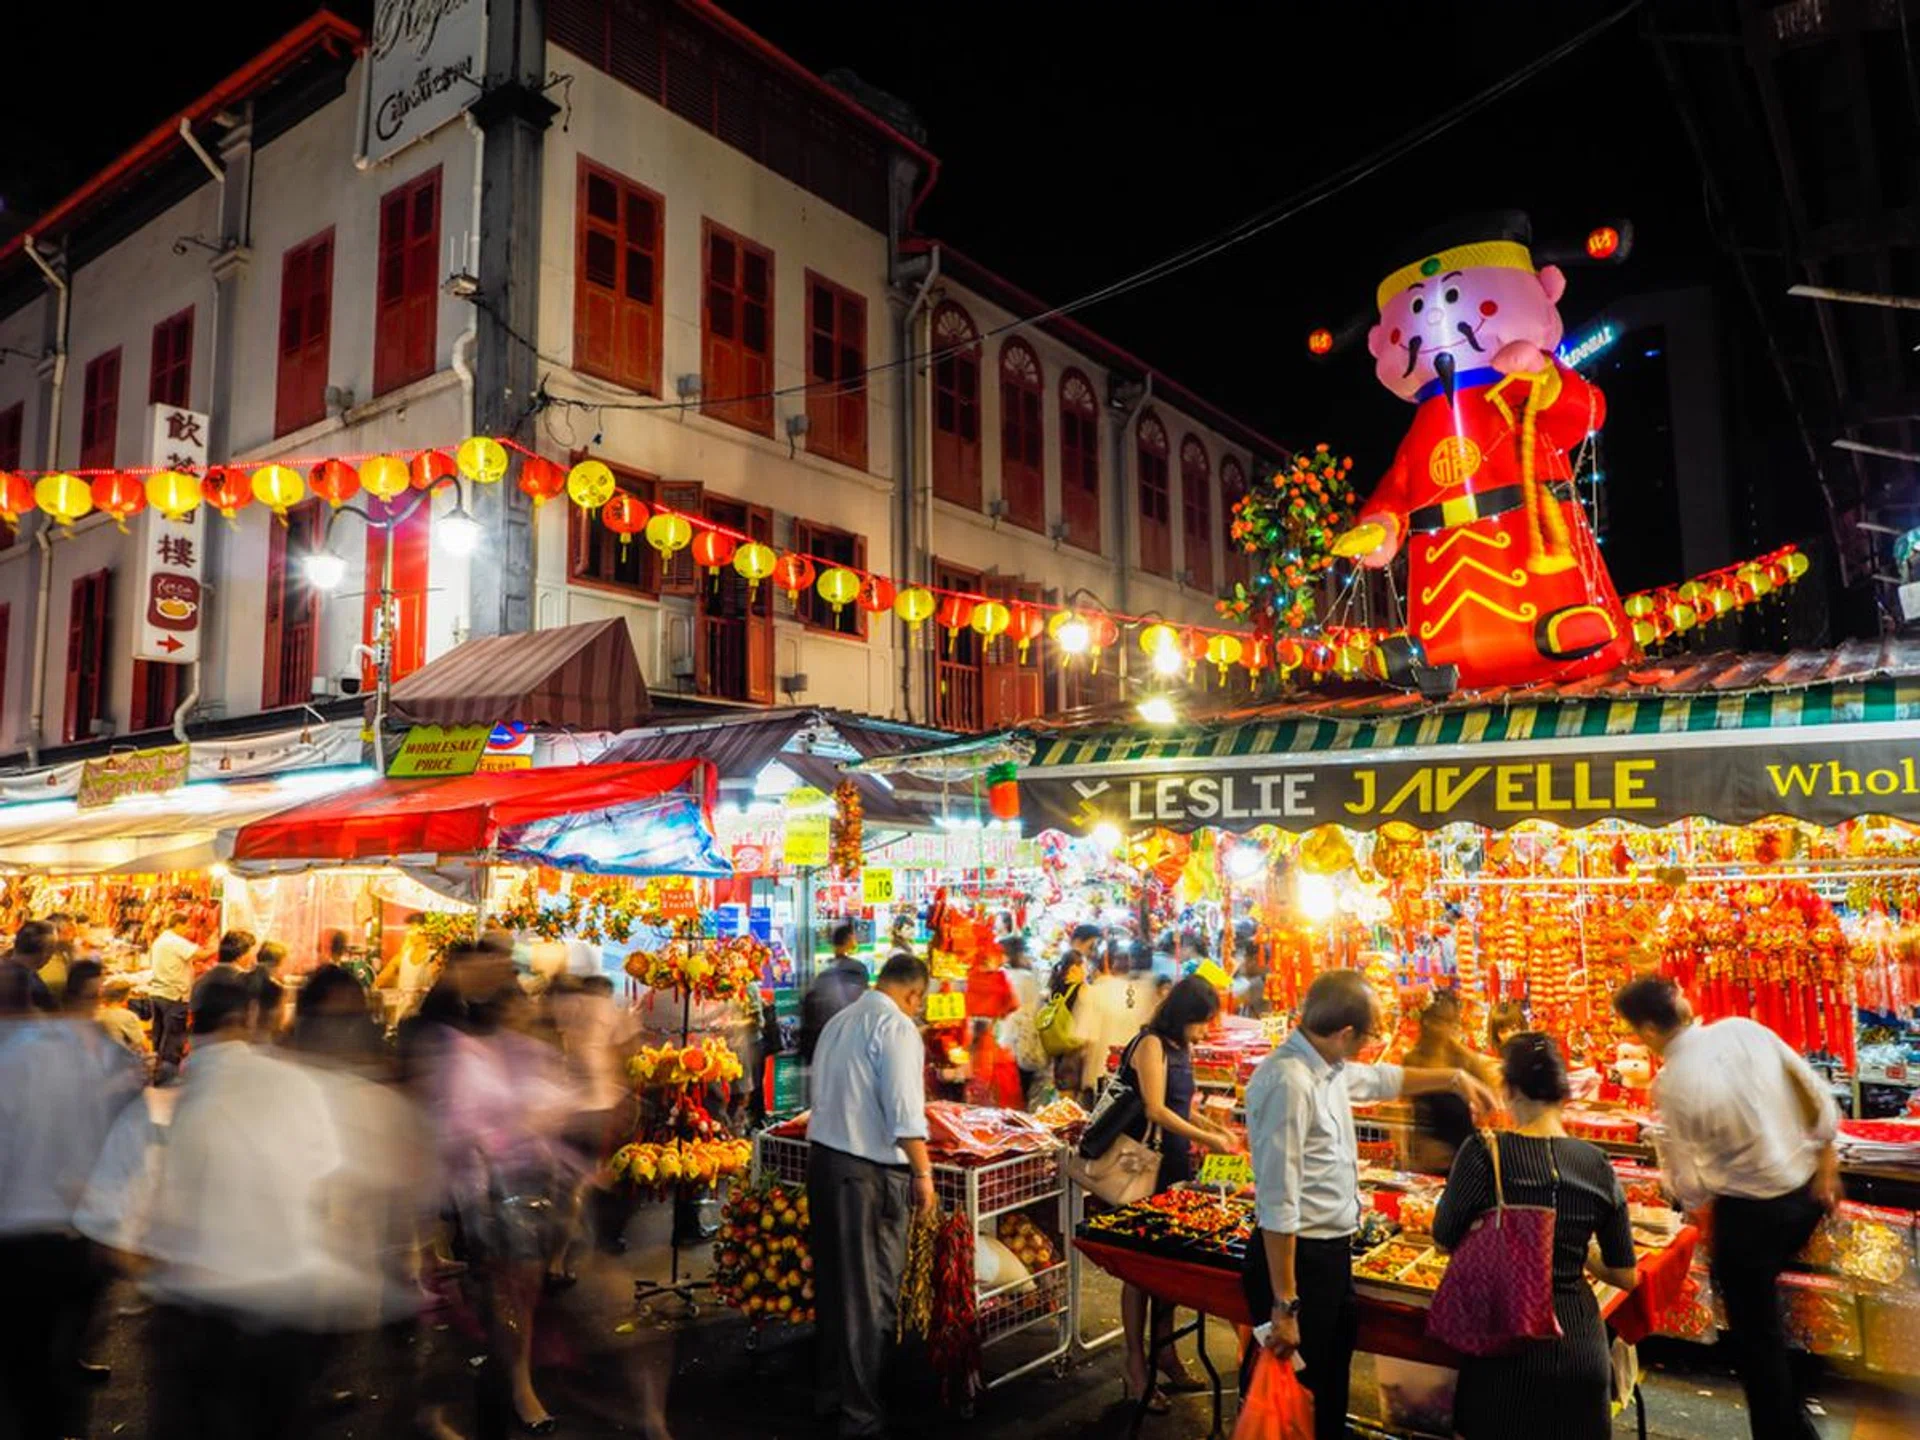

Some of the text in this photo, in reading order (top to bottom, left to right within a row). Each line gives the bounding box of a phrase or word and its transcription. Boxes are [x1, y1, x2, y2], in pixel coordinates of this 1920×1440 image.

[405, 739, 481, 755] WHOLESALE
[414, 757, 455, 771] PRICE
[1129, 773, 1315, 820] LESLIE
[1344, 759, 1656, 814] JAVELLE
[1766, 757, 1920, 797] Whol
